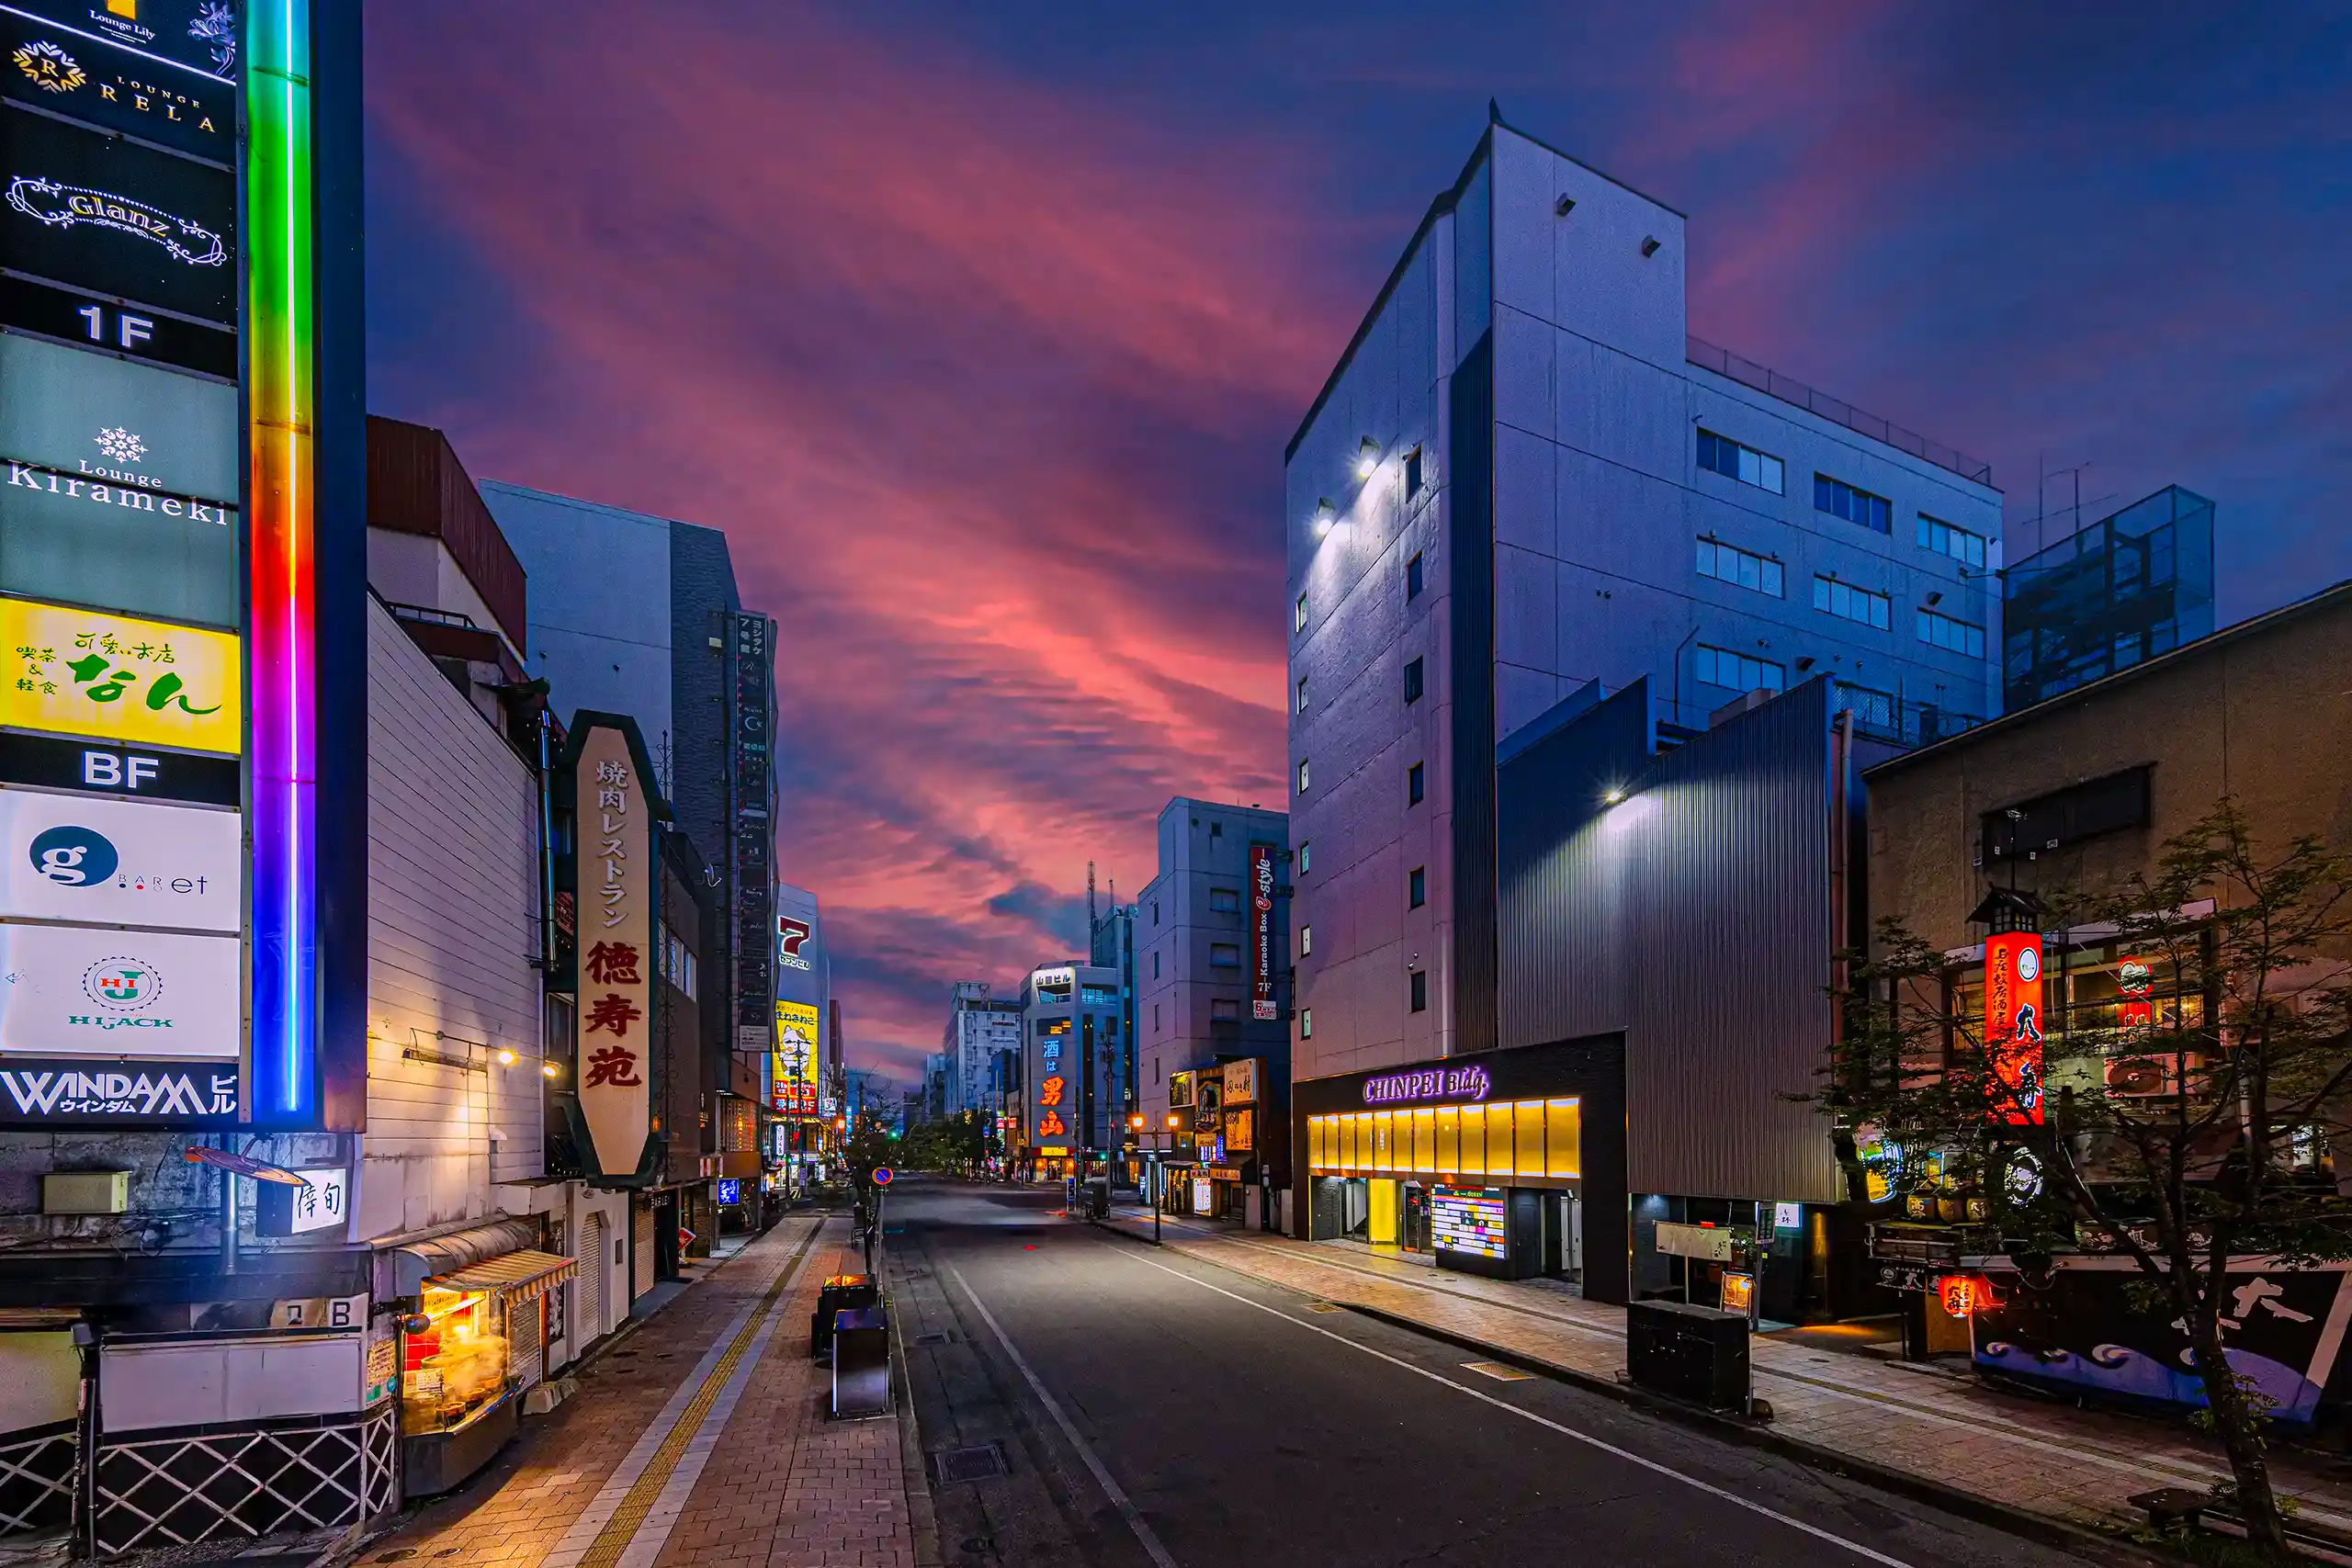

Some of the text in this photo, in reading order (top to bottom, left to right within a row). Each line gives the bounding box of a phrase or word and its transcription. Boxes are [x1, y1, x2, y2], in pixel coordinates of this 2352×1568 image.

[89, 9, 132, 31] Lounge
[133, 24, 156, 40] Lily
[41, 58, 60, 77] R
[100, 84, 216, 133] RELA
[118, 76, 200, 108] LOUNGE
[68, 195, 172, 238] Glanz
[79, 307, 153, 348] 1F
[79, 459, 162, 488] Lounge
[7, 459, 228, 525] Kirameki
[16, 646, 57, 663] 喫茶
[28, 663, 43, 676] &
[16, 678, 58, 695] 軽食
[65, 653, 222, 716] なん
[84, 751, 160, 789] BF
[595, 760, 628, 929] 焼肉レストラン
[777, 915, 811, 957] 7
[1260, 912, 1268, 976] Karaoke Box
[1035, 974, 1071, 986] 山田ビル
[1258, 981, 1272, 993] 7F
[69, 1015, 173, 1030] HIJACK
[584, 940, 643, 1090] 徳寿苑
[1043, 1039, 1059, 1072] 酒は
[209, 1075, 237, 1114] ビル
[1363, 1066, 1487, 1101] CHINPEI Bldg.
[60, 1100, 137, 1113] ウインダム
[1039, 1077, 1065, 1136] 男山
